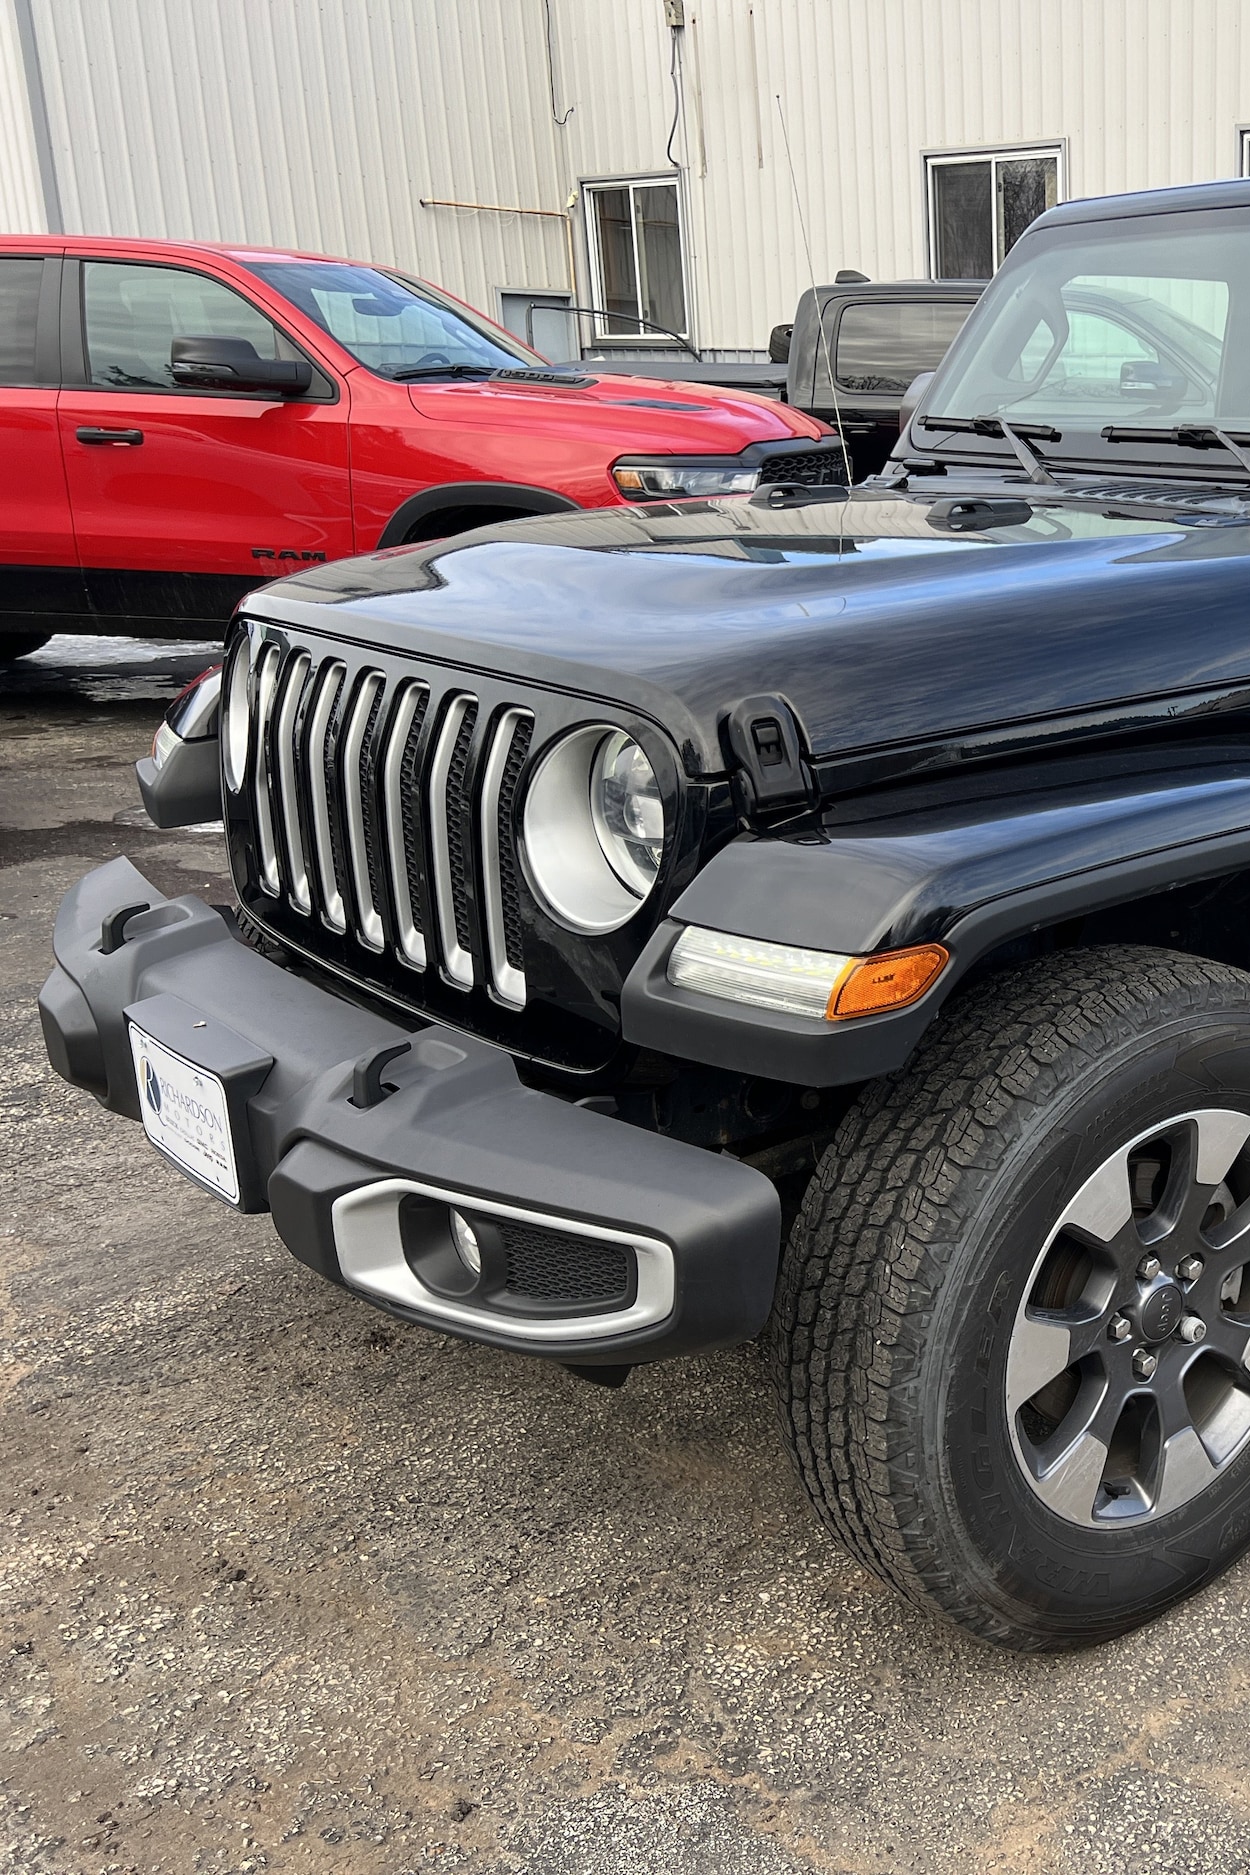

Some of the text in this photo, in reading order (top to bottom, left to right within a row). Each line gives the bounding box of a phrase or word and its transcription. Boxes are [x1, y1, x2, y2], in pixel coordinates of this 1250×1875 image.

[251, 547, 327, 562] RAM
[159, 1077, 223, 1134] RICHARDSON
[970, 1269, 1112, 1598] WRANGLER
